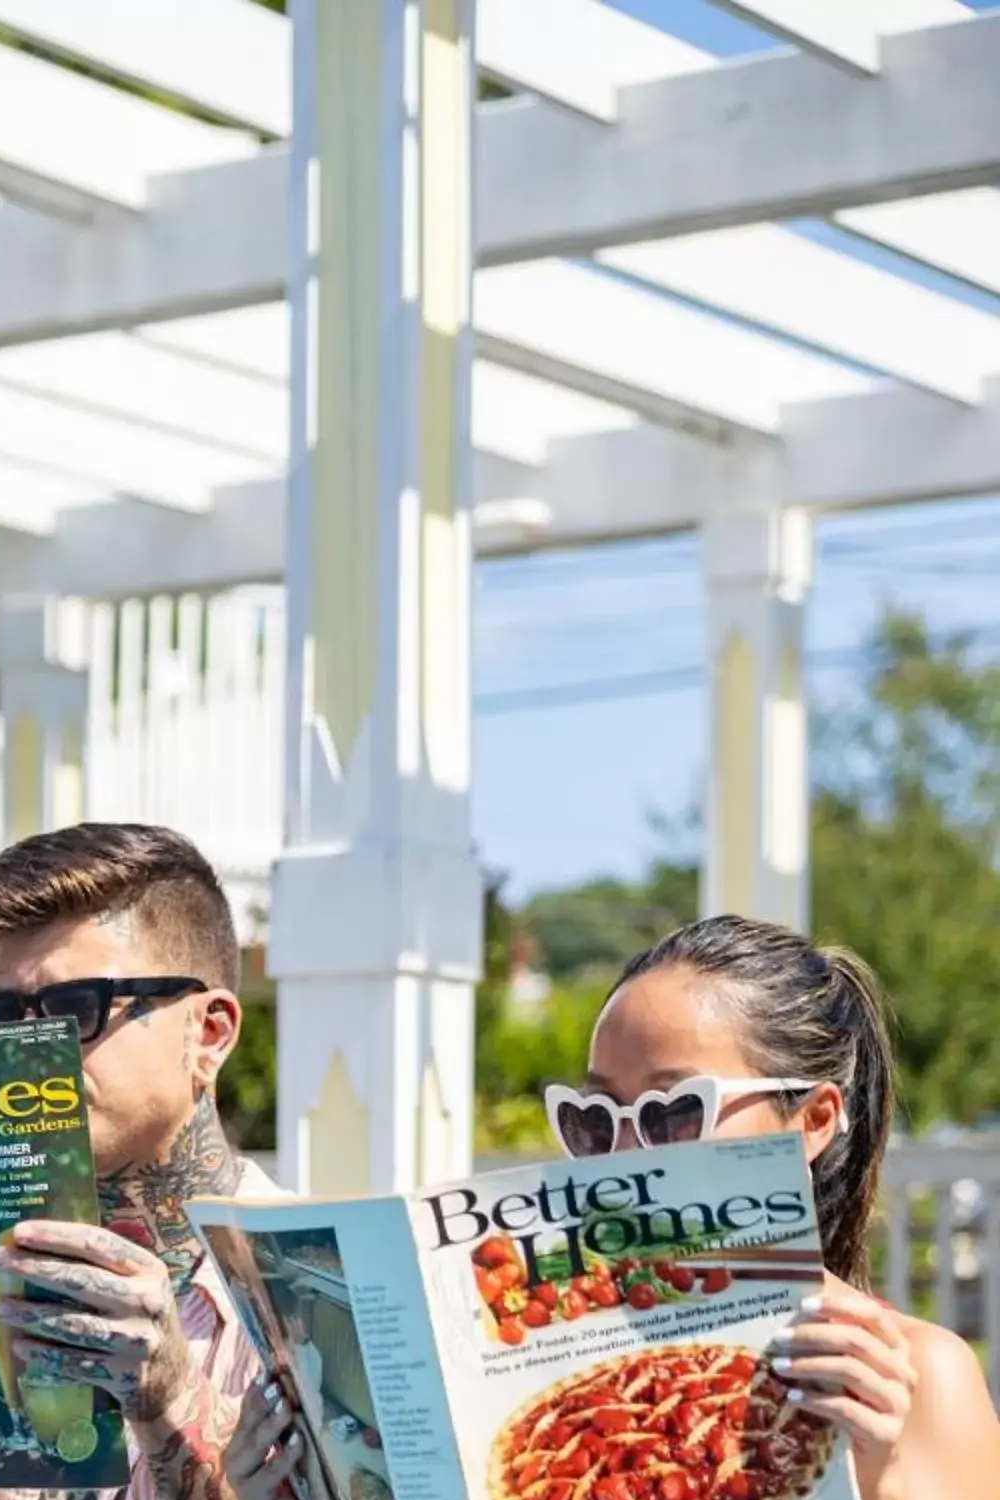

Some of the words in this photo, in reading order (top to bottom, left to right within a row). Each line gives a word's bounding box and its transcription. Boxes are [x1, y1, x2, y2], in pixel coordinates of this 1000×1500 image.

[424, 1166, 666, 1252] Better
[515, 1189, 808, 1288] Homes
[672, 1237, 711, 1259] and
[481, 1344, 533, 1362] Summer
[581, 1328, 598, 1342] 20
[600, 1312, 672, 1337] spectacular
[675, 1301, 736, 1321] barbecue
[737, 1288, 791, 1308] recipes!
[484, 1364, 512, 1377] Plus
[514, 1363, 523, 1371] a
[525, 1351, 573, 1368] dessert
[643, 1320, 715, 1344] strawberry
[718, 1307, 770, 1328] rhubarb
